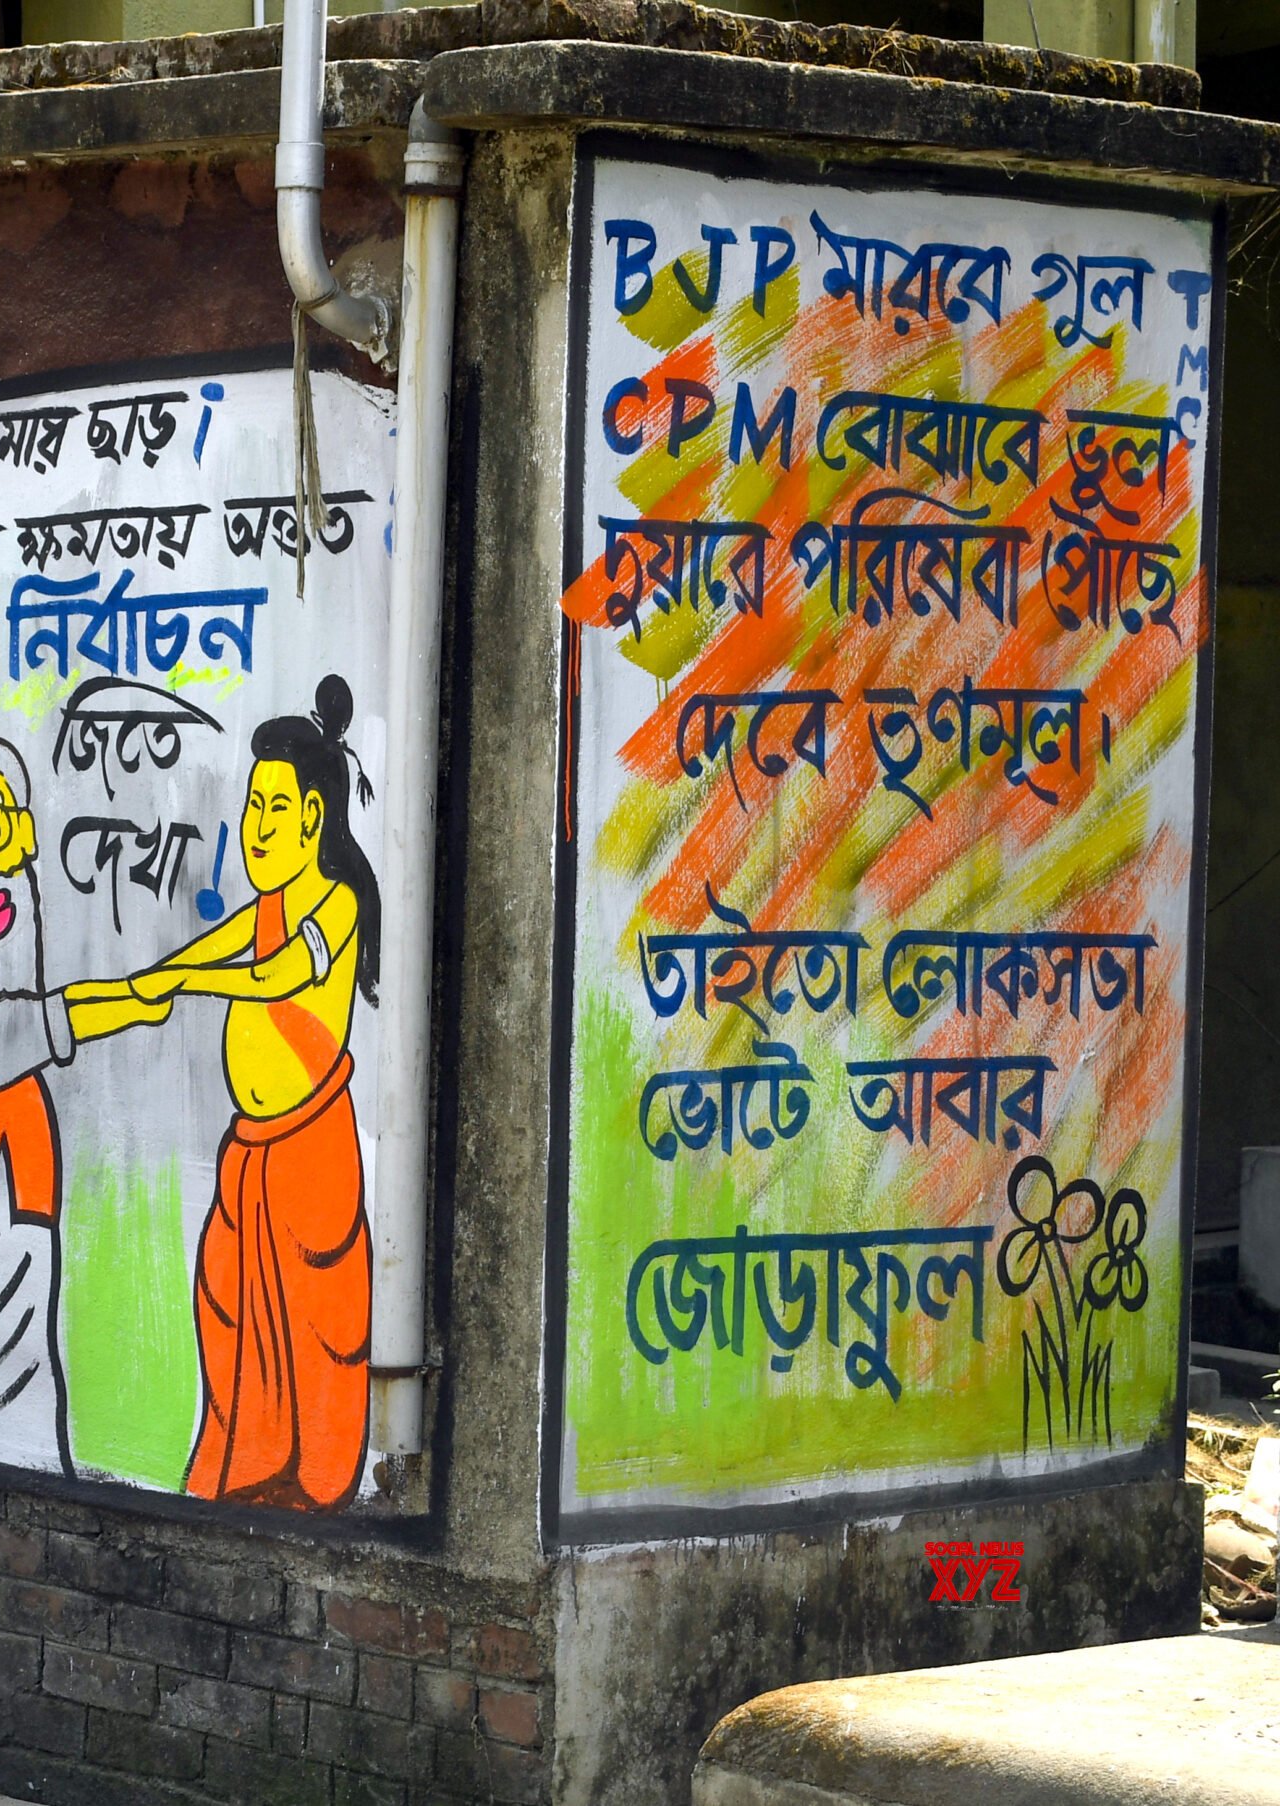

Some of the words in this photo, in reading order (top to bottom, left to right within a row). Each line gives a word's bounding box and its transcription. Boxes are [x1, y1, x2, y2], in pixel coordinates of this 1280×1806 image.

[605, 218, 797, 319] BJP
[1032, 255, 1155, 349] গুল
[602, 376, 797, 471] CPM
[1067, 409, 1183, 525] ভুল
[14, 503, 212, 573] ক্ষমতায়
[599, 514, 776, 642] দুয়ারে
[791, 488, 1032, 628] পরিষেবা
[6, 568, 269, 682] নির্বাচন
[52, 676, 227, 802] জিতে
[675, 688, 843, 813] দেবে
[637, 880, 871, 1037] তাইতো
[883, 928, 1158, 1023] লোকসভা
[639, 1040, 814, 1161] ভোটে
[846, 1055, 1059, 1150] আবার
[626, 1225, 994, 1403] জোড়াফুল
